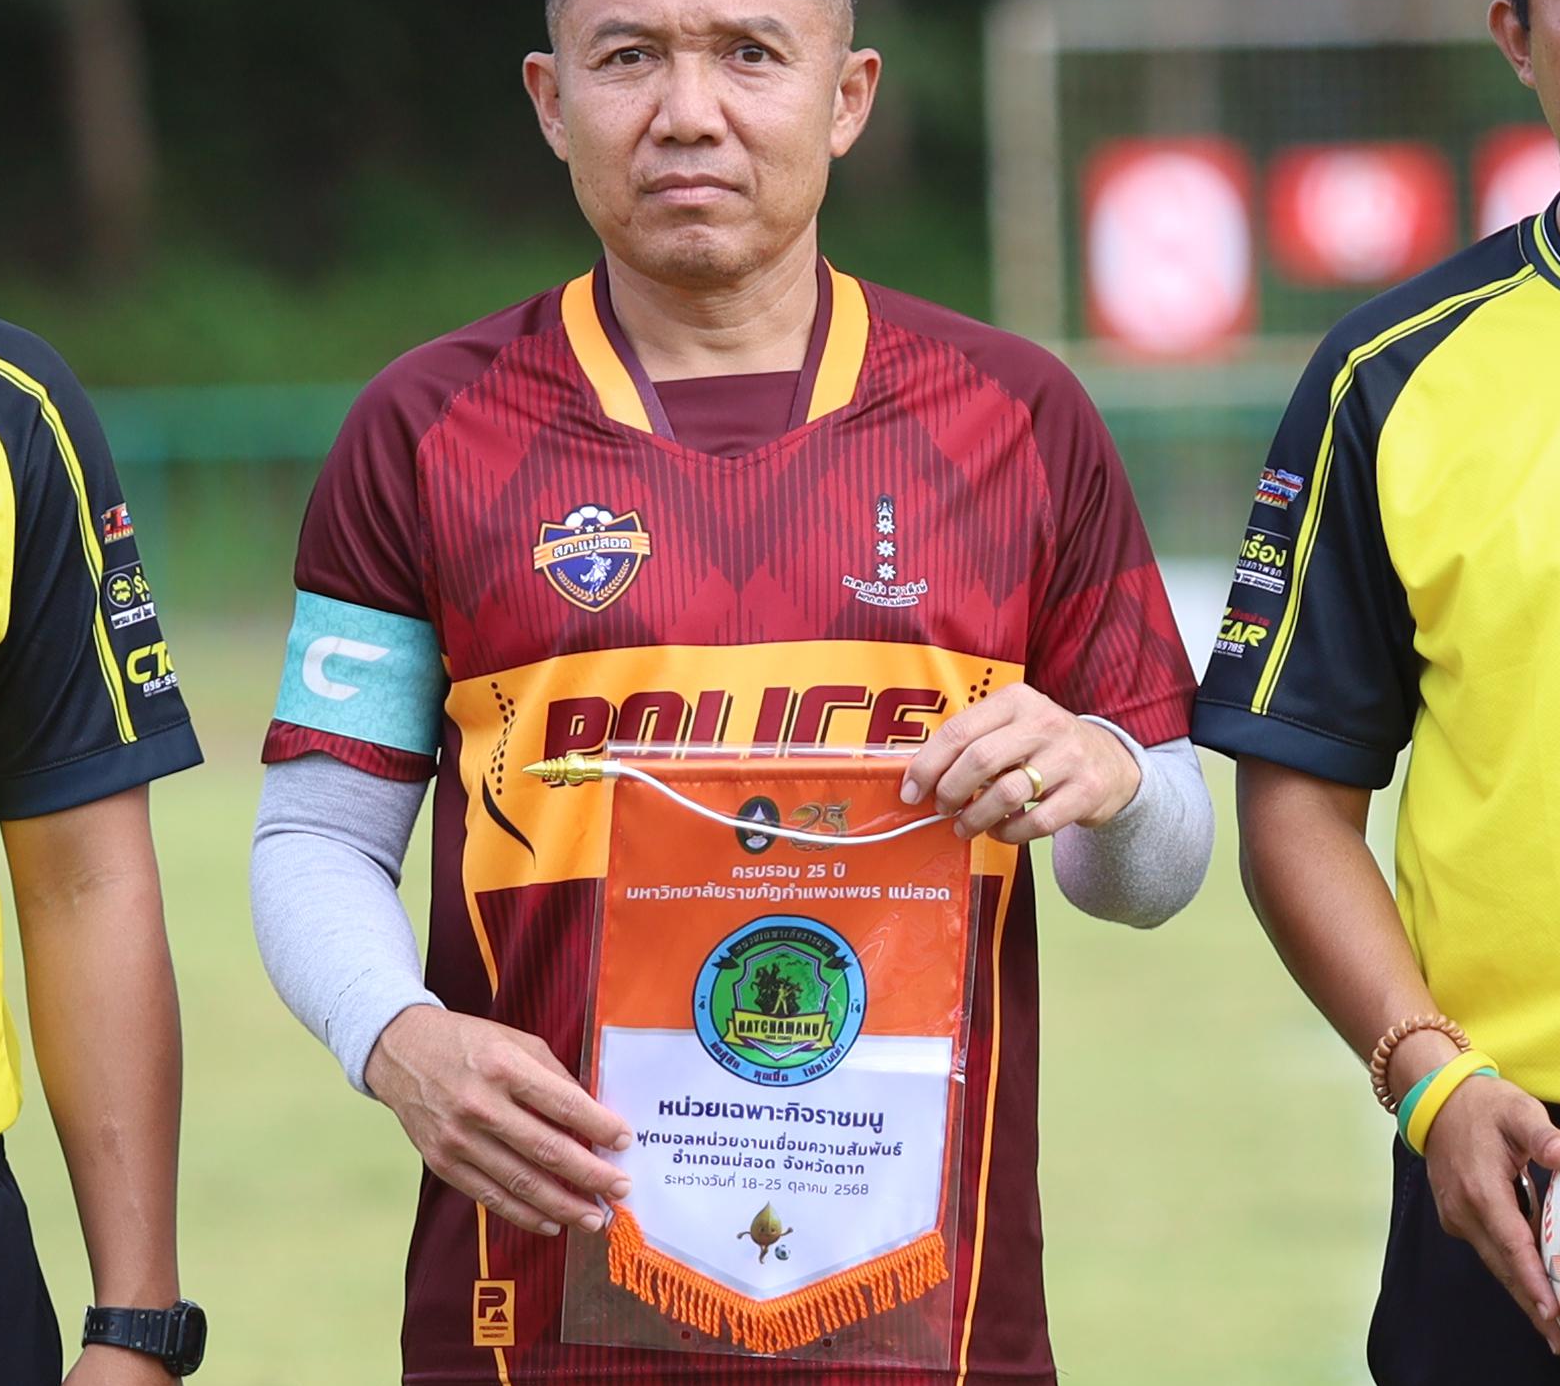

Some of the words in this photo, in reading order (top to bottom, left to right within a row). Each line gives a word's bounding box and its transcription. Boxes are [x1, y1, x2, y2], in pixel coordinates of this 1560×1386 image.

[552, 535, 631, 558] สภ.แม่สอด
[1241, 533, 1287, 567] เรือง
[542, 685, 947, 787] POLICE
[731, 863, 801, 880] ครบรอบ
[806, 863, 826, 879] 25
[833, 860, 847, 879] ปี
[626, 881, 882, 903] มหาวิทยาลัยราชภัฏกำแพงเพชร
[888, 883, 951, 902] แม่สอด
[658, 1095, 884, 1134] หน่วยเฉพาะกิจราชมนู
[636, 1131, 904, 1158] ฟุตบอลหน่วยงานเชื่อมความสัมพันธ์
[672, 1148, 777, 1170] อำเภอแม่สอด
[783, 1156, 865, 1176] จังหวัดตาก
[664, 1172, 736, 1189] ระหว่างวันที่
[741, 1177, 782, 1191] 18-25
[787, 1182, 828, 1196] ตุลาคม
[834, 1183, 870, 1196] 2568
